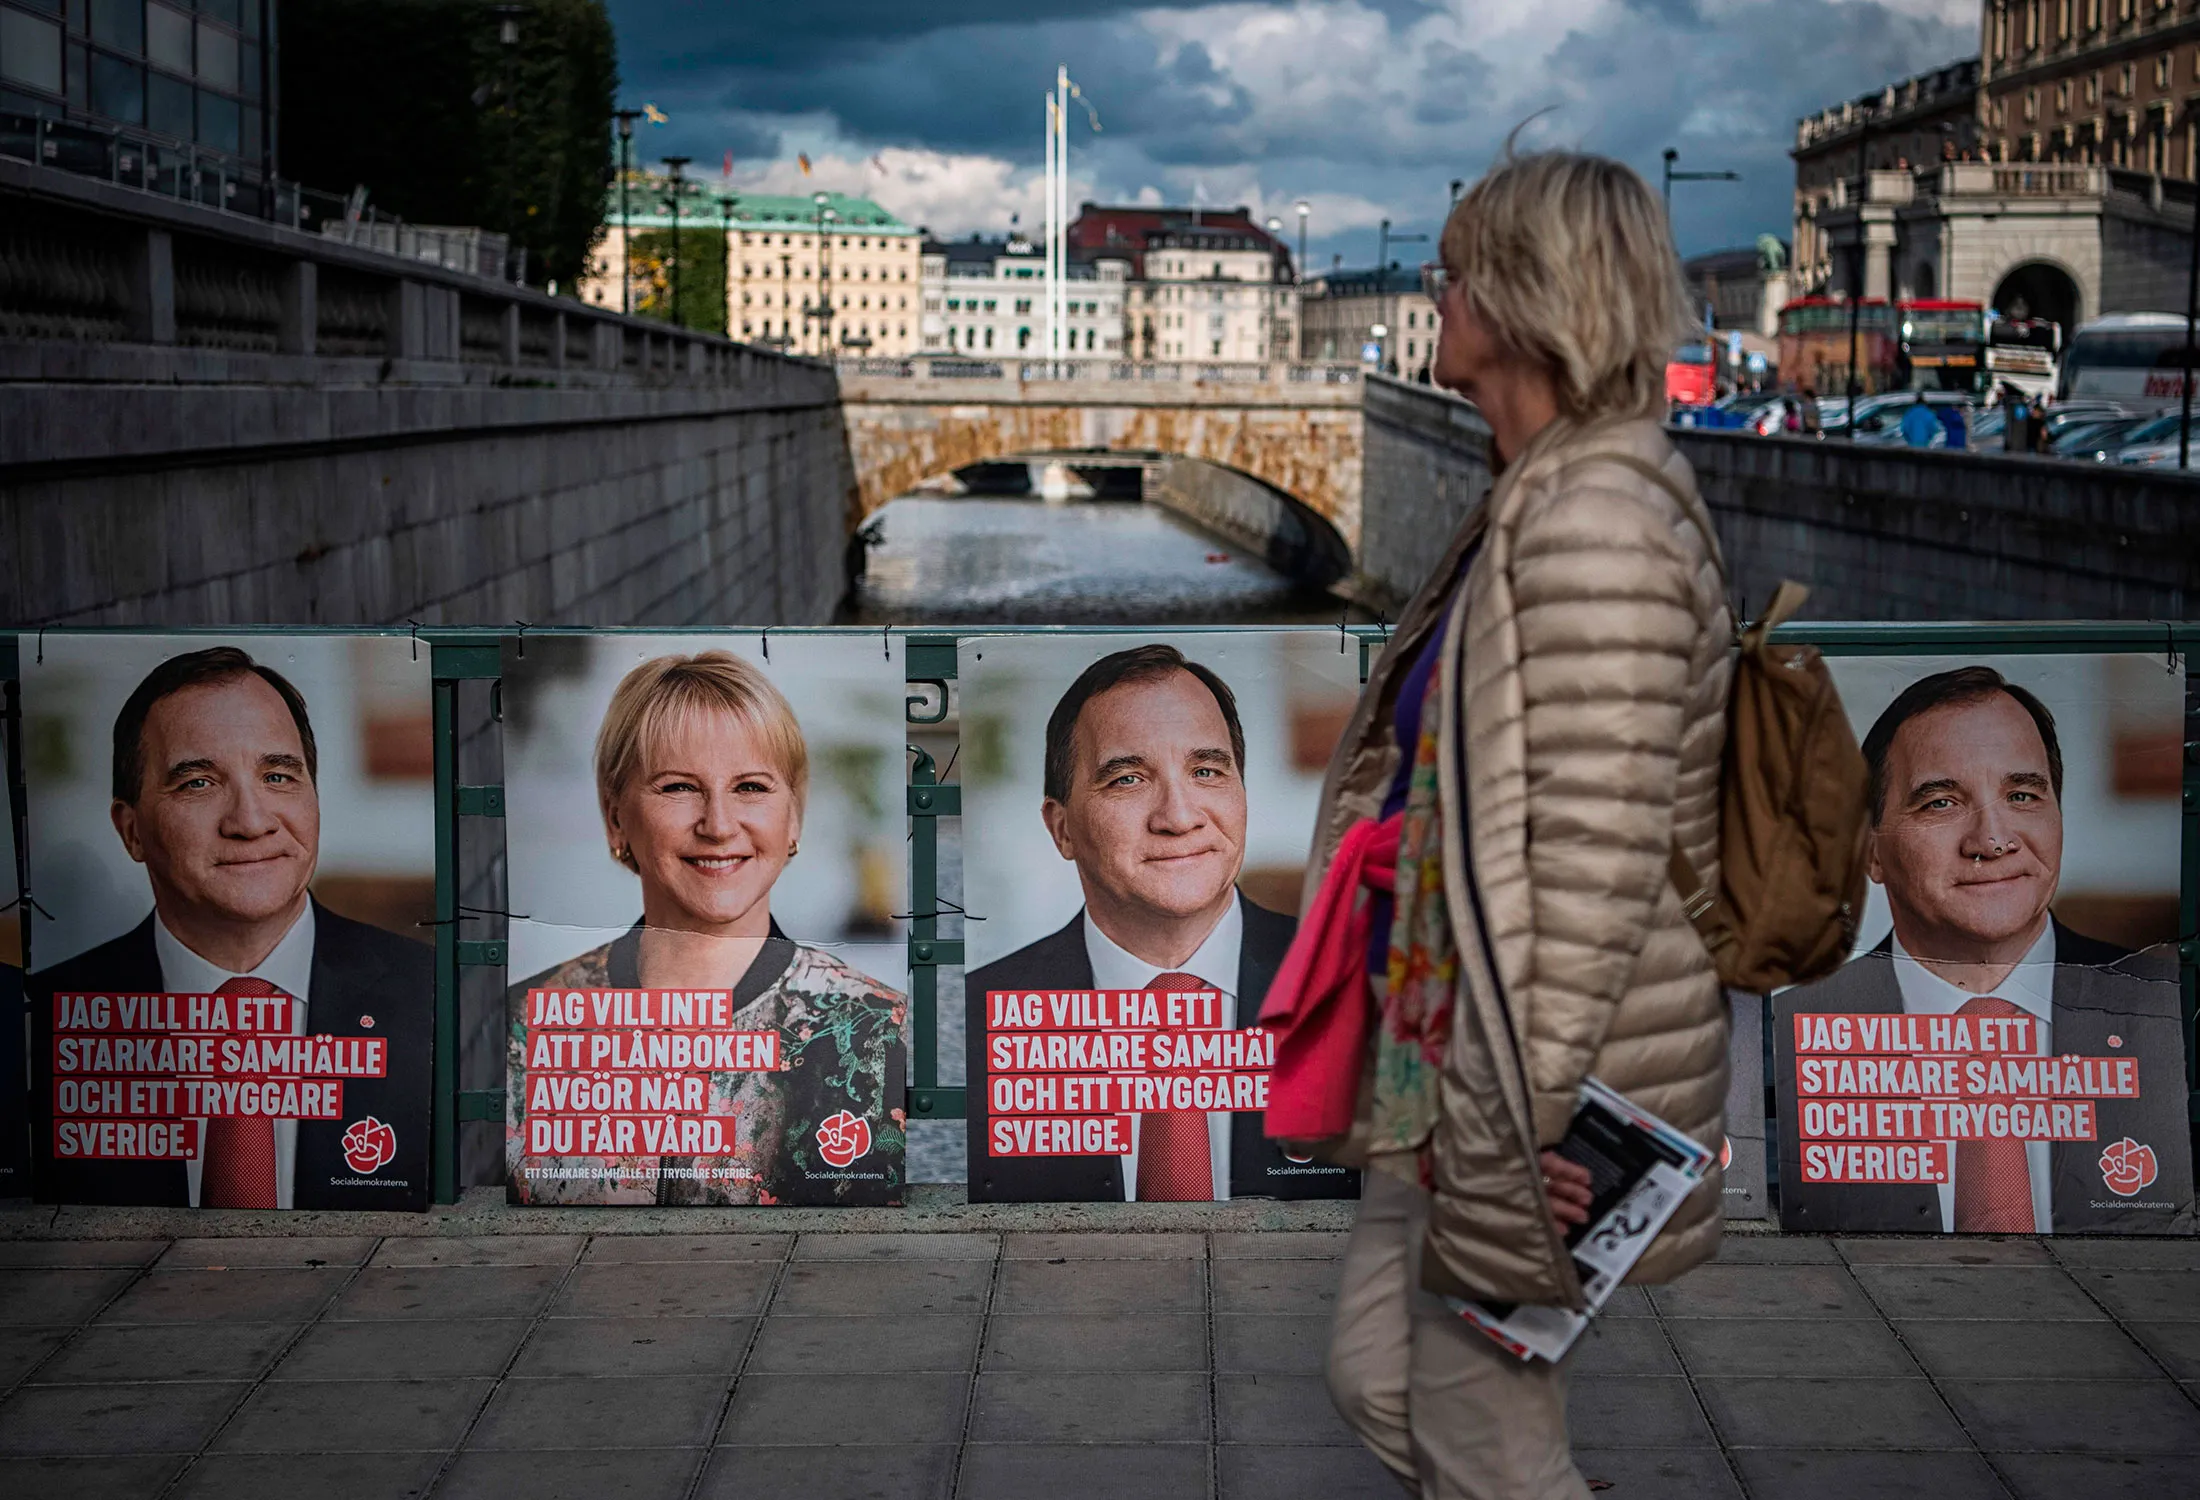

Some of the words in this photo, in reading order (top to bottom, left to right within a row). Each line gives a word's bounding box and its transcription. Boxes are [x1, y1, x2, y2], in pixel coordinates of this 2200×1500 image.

[58, 995, 111, 1030] JAG
[116, 996, 182, 1030] VILL
[188, 996, 230, 1031] HA
[237, 997, 287, 1031] ETT
[532, 991, 585, 1026] JAG
[590, 992, 655, 1026] VILL
[661, 992, 727, 1026] INTE
[991, 993, 1043, 1028] JAG
[1048, 993, 1113, 1027] VILL
[1118, 992, 1161, 1026] HA
[1166, 992, 1216, 1026] ETT
[531, 1034, 585, 1068] ATT
[590, 1029, 775, 1069] PLÅNBOKEN
[992, 1034, 1146, 1070] STARKARE
[1800, 1016, 1852, 1051] JAG
[1857, 1017, 1924, 1051] VILL
[1929, 1017, 1974, 1052] HA
[1979, 1017, 2030, 1052] ETT
[58, 1038, 215, 1073] STARKARE
[221, 1034, 382, 1075] SAMHÄLLE
[531, 1071, 634, 1111] AVGÖR
[640, 1071, 704, 1111] NÄR
[1801, 1059, 1960, 1094] STARKARE
[1965, 1054, 2133, 1095] SAMHÄLLE
[59, 1080, 123, 1114] OCH
[130, 1080, 180, 1115] ETT
[184, 1081, 338, 1117] TRYGGARE
[993, 1077, 1056, 1112] OCH
[1063, 1076, 1113, 1111] ETT
[1116, 1075, 1270, 1110] TRYGGARE
[531, 1119, 574, 1154] DU
[579, 1113, 638, 1153] FÅR
[642, 1112, 733, 1153] VÅRD.
[993, 1118, 1129, 1154] SVERIGE.
[1804, 1102, 1869, 1137] OCH
[1875, 1102, 1925, 1137] ETT
[1929, 1103, 2091, 1138] TRYGGARE
[59, 1122, 194, 1157] SVERIGE.
[524, 1167, 541, 1180] ETT
[542, 1167, 590, 1180] STARKARE
[591, 1166, 644, 1180] SAMHÄLLE.
[646, 1167, 661, 1180] ETT
[662, 1167, 710, 1180] TRYGGARE
[711, 1167, 754, 1181] SVERIGE.
[805, 1170, 884, 1180] Socialdemokraterna
[1267, 1167, 1345, 1176] Socialdemokraterna
[1805, 1145, 1945, 1181] SVERIGE.
[331, 1177, 407, 1187] Socialdemokraterna
[2090, 1200, 2174, 1209] Socialdemokraterna
